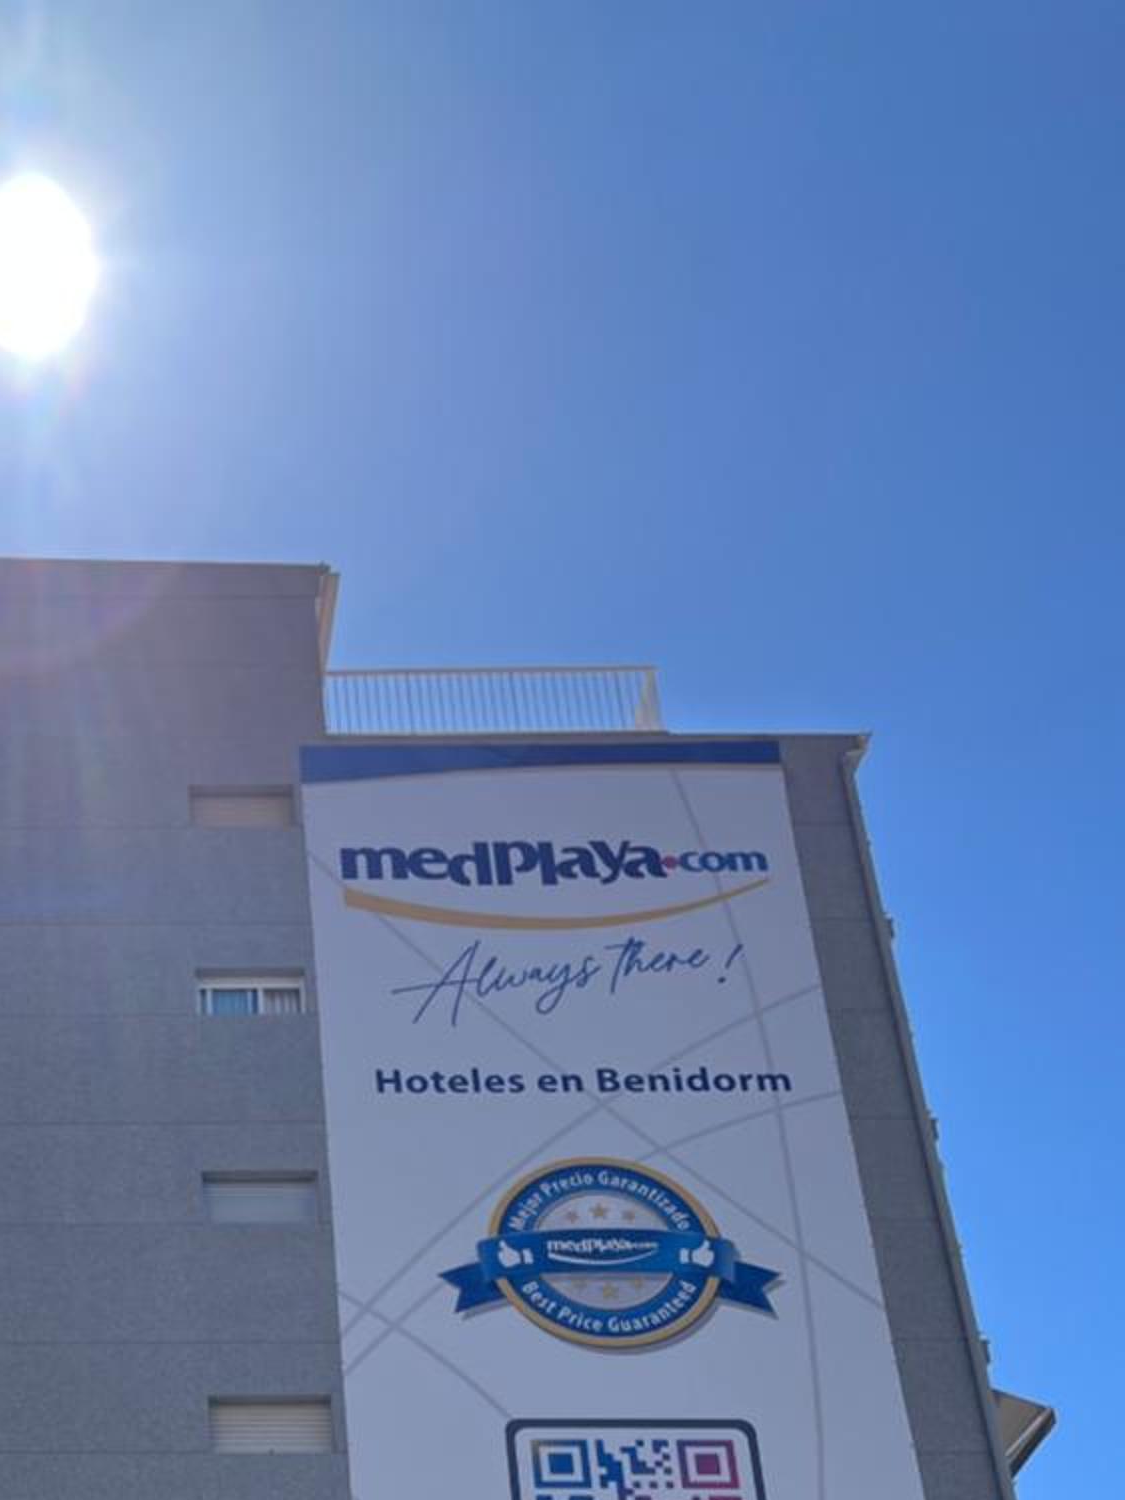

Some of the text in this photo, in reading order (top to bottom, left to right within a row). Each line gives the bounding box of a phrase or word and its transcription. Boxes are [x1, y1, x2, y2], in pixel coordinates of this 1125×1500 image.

[392, 941, 600, 1026] Always
[376, 1067, 791, 1093] Hoteles en Benidorm
[508, 1170, 690, 1231] Mejor Precio Garantizado
[522, 1280, 697, 1333] Best Price Guaranteed
